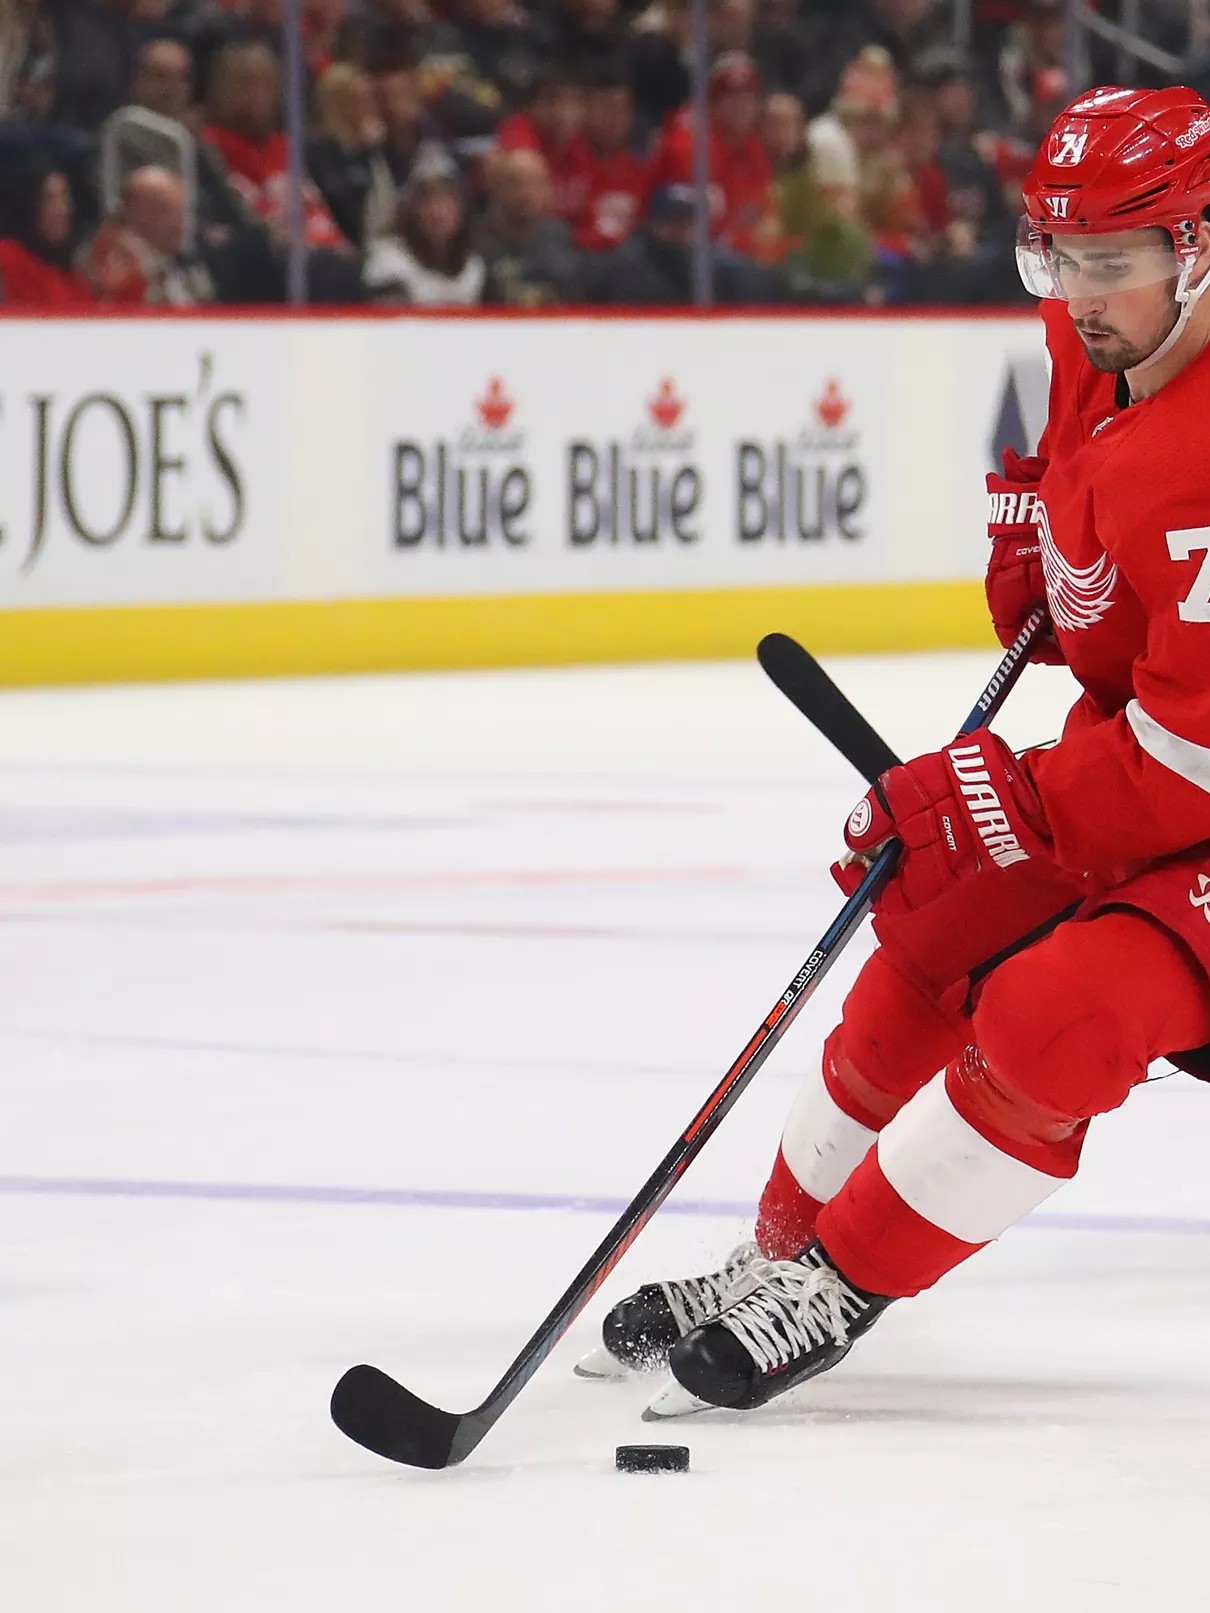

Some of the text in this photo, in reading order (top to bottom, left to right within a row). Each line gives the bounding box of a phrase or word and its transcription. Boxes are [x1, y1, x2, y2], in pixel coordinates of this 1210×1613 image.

[1175, 128, 1198, 149] Red
[17, 349, 247, 576] JOE'S
[393, 438, 867, 550] Blue Blue Blue
[793, 950, 824, 989] COVERT
